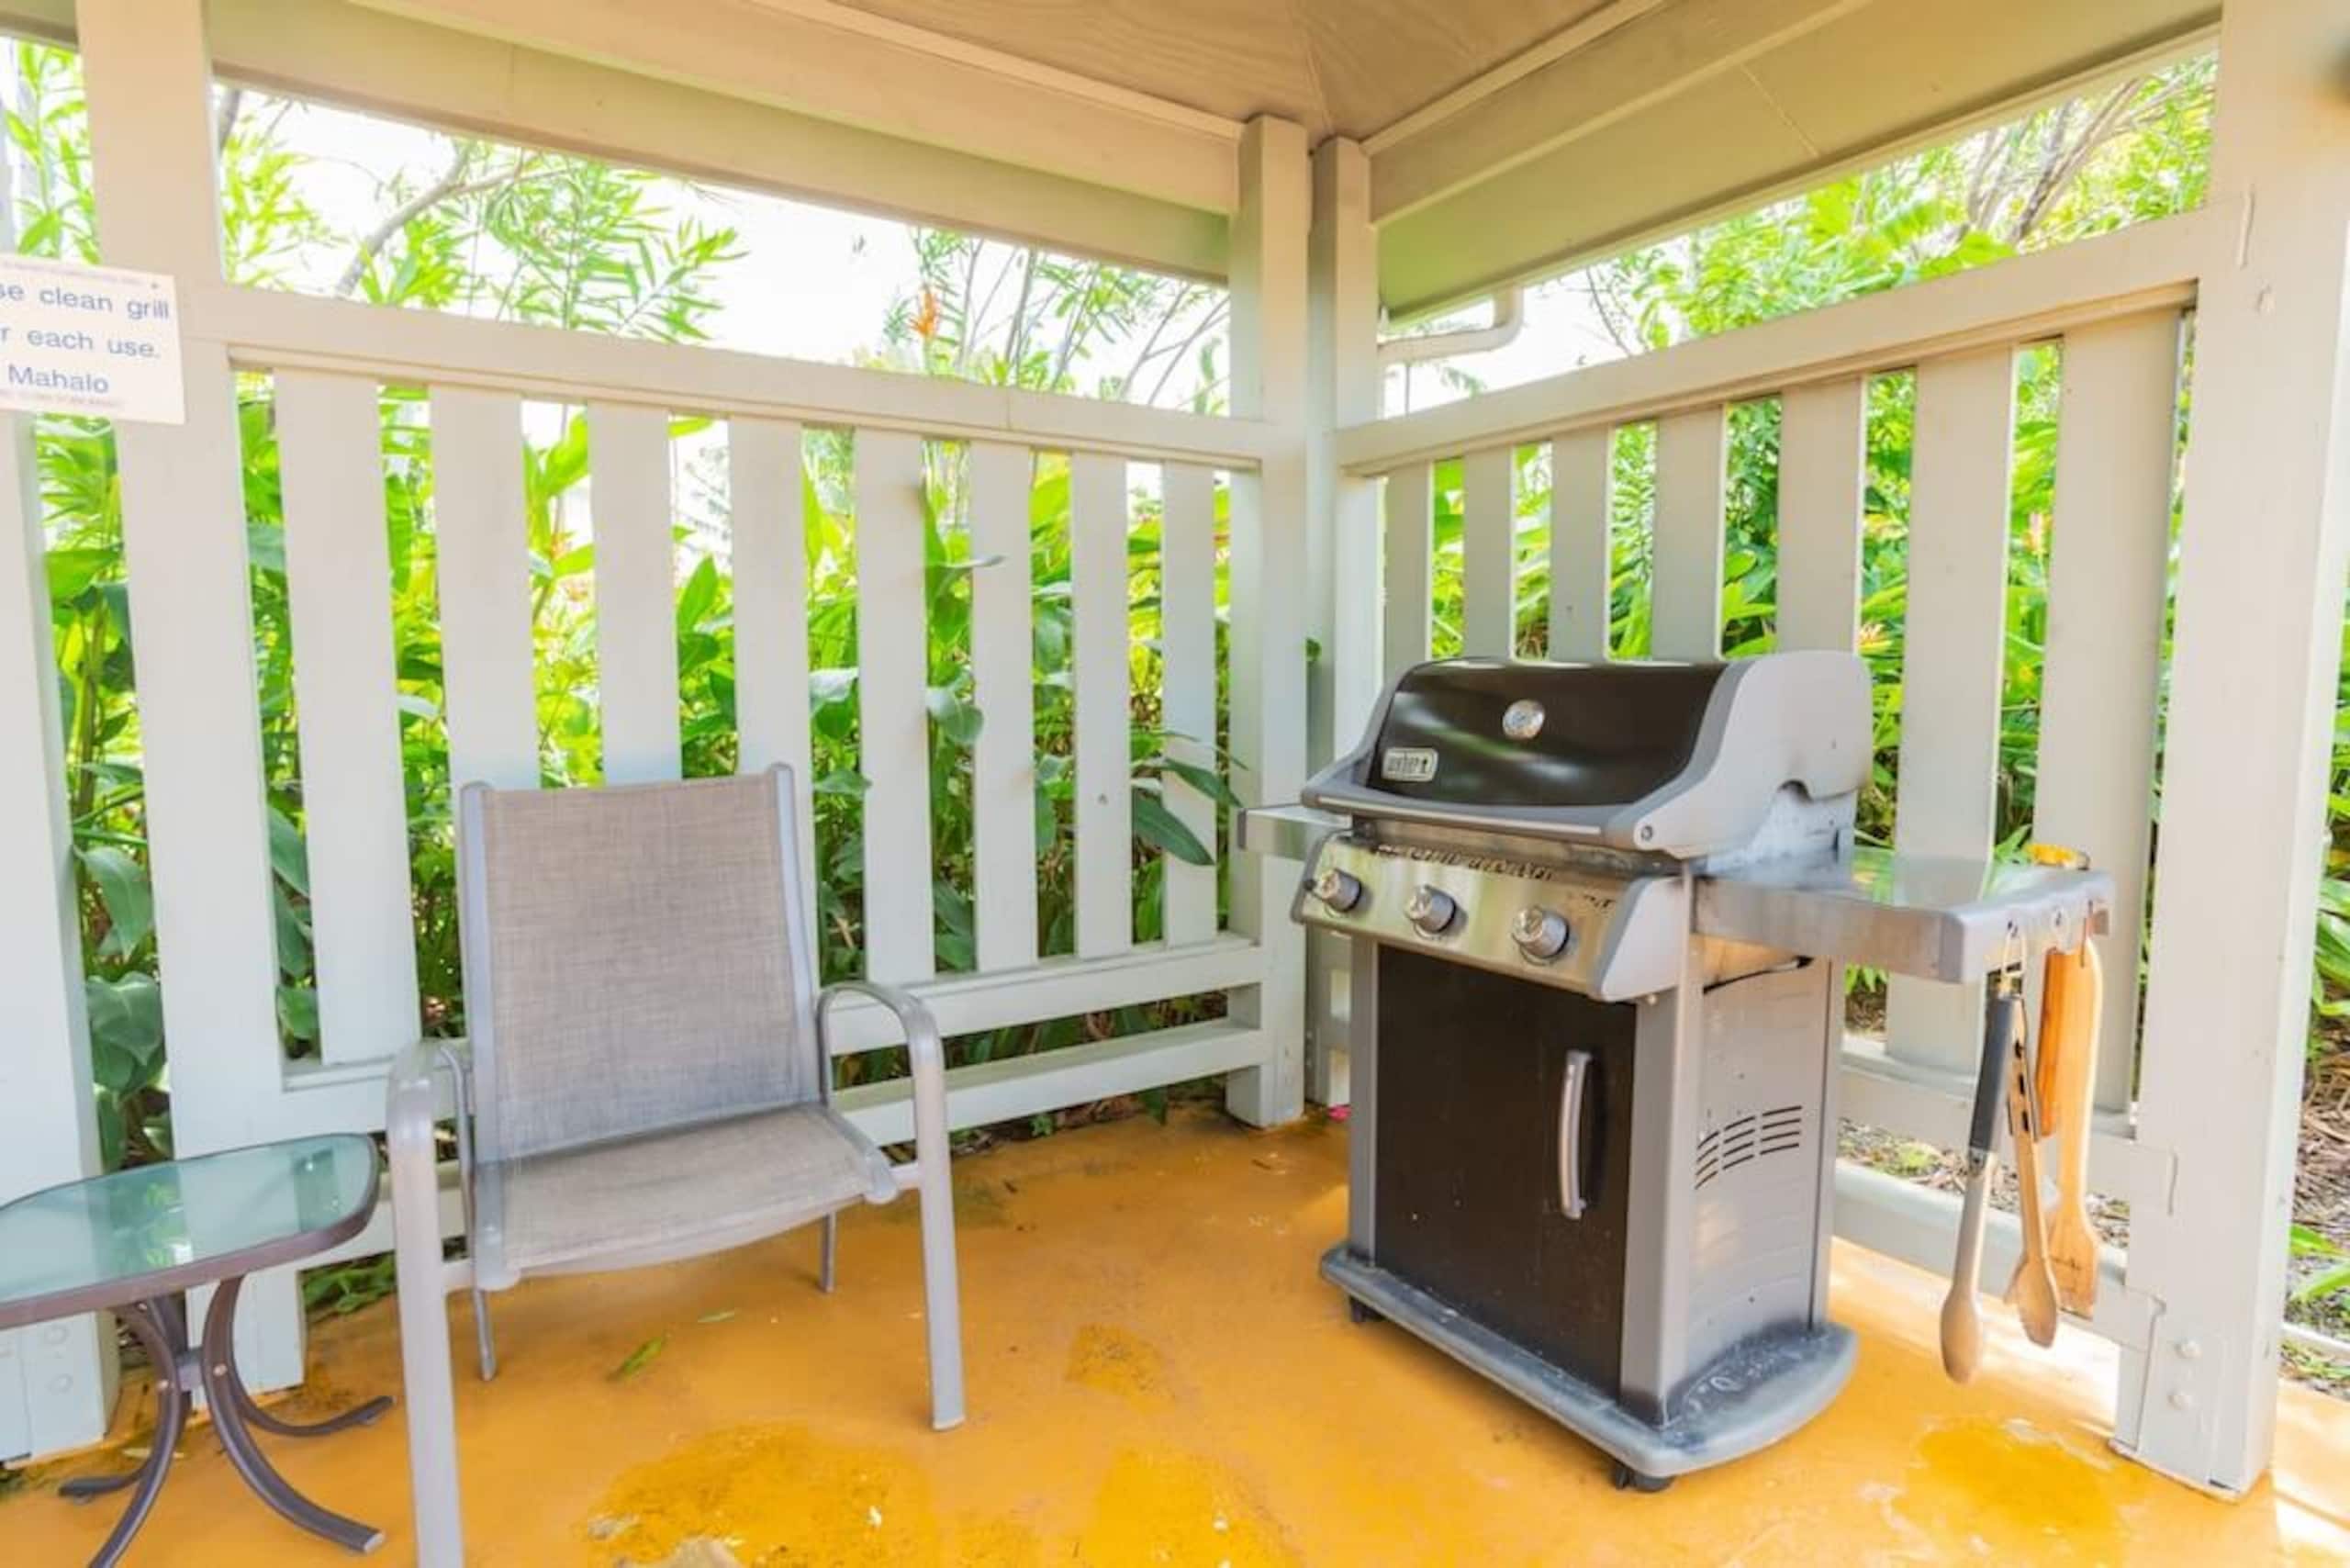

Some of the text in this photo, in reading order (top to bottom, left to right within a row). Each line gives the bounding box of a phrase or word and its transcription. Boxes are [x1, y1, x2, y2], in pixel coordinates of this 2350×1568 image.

[39, 286, 113, 313] clean
[127, 298, 169, 319] grill
[28, 330, 94, 351] each
[107, 338, 161, 358] use.
[8, 364, 109, 394] Mahalo
